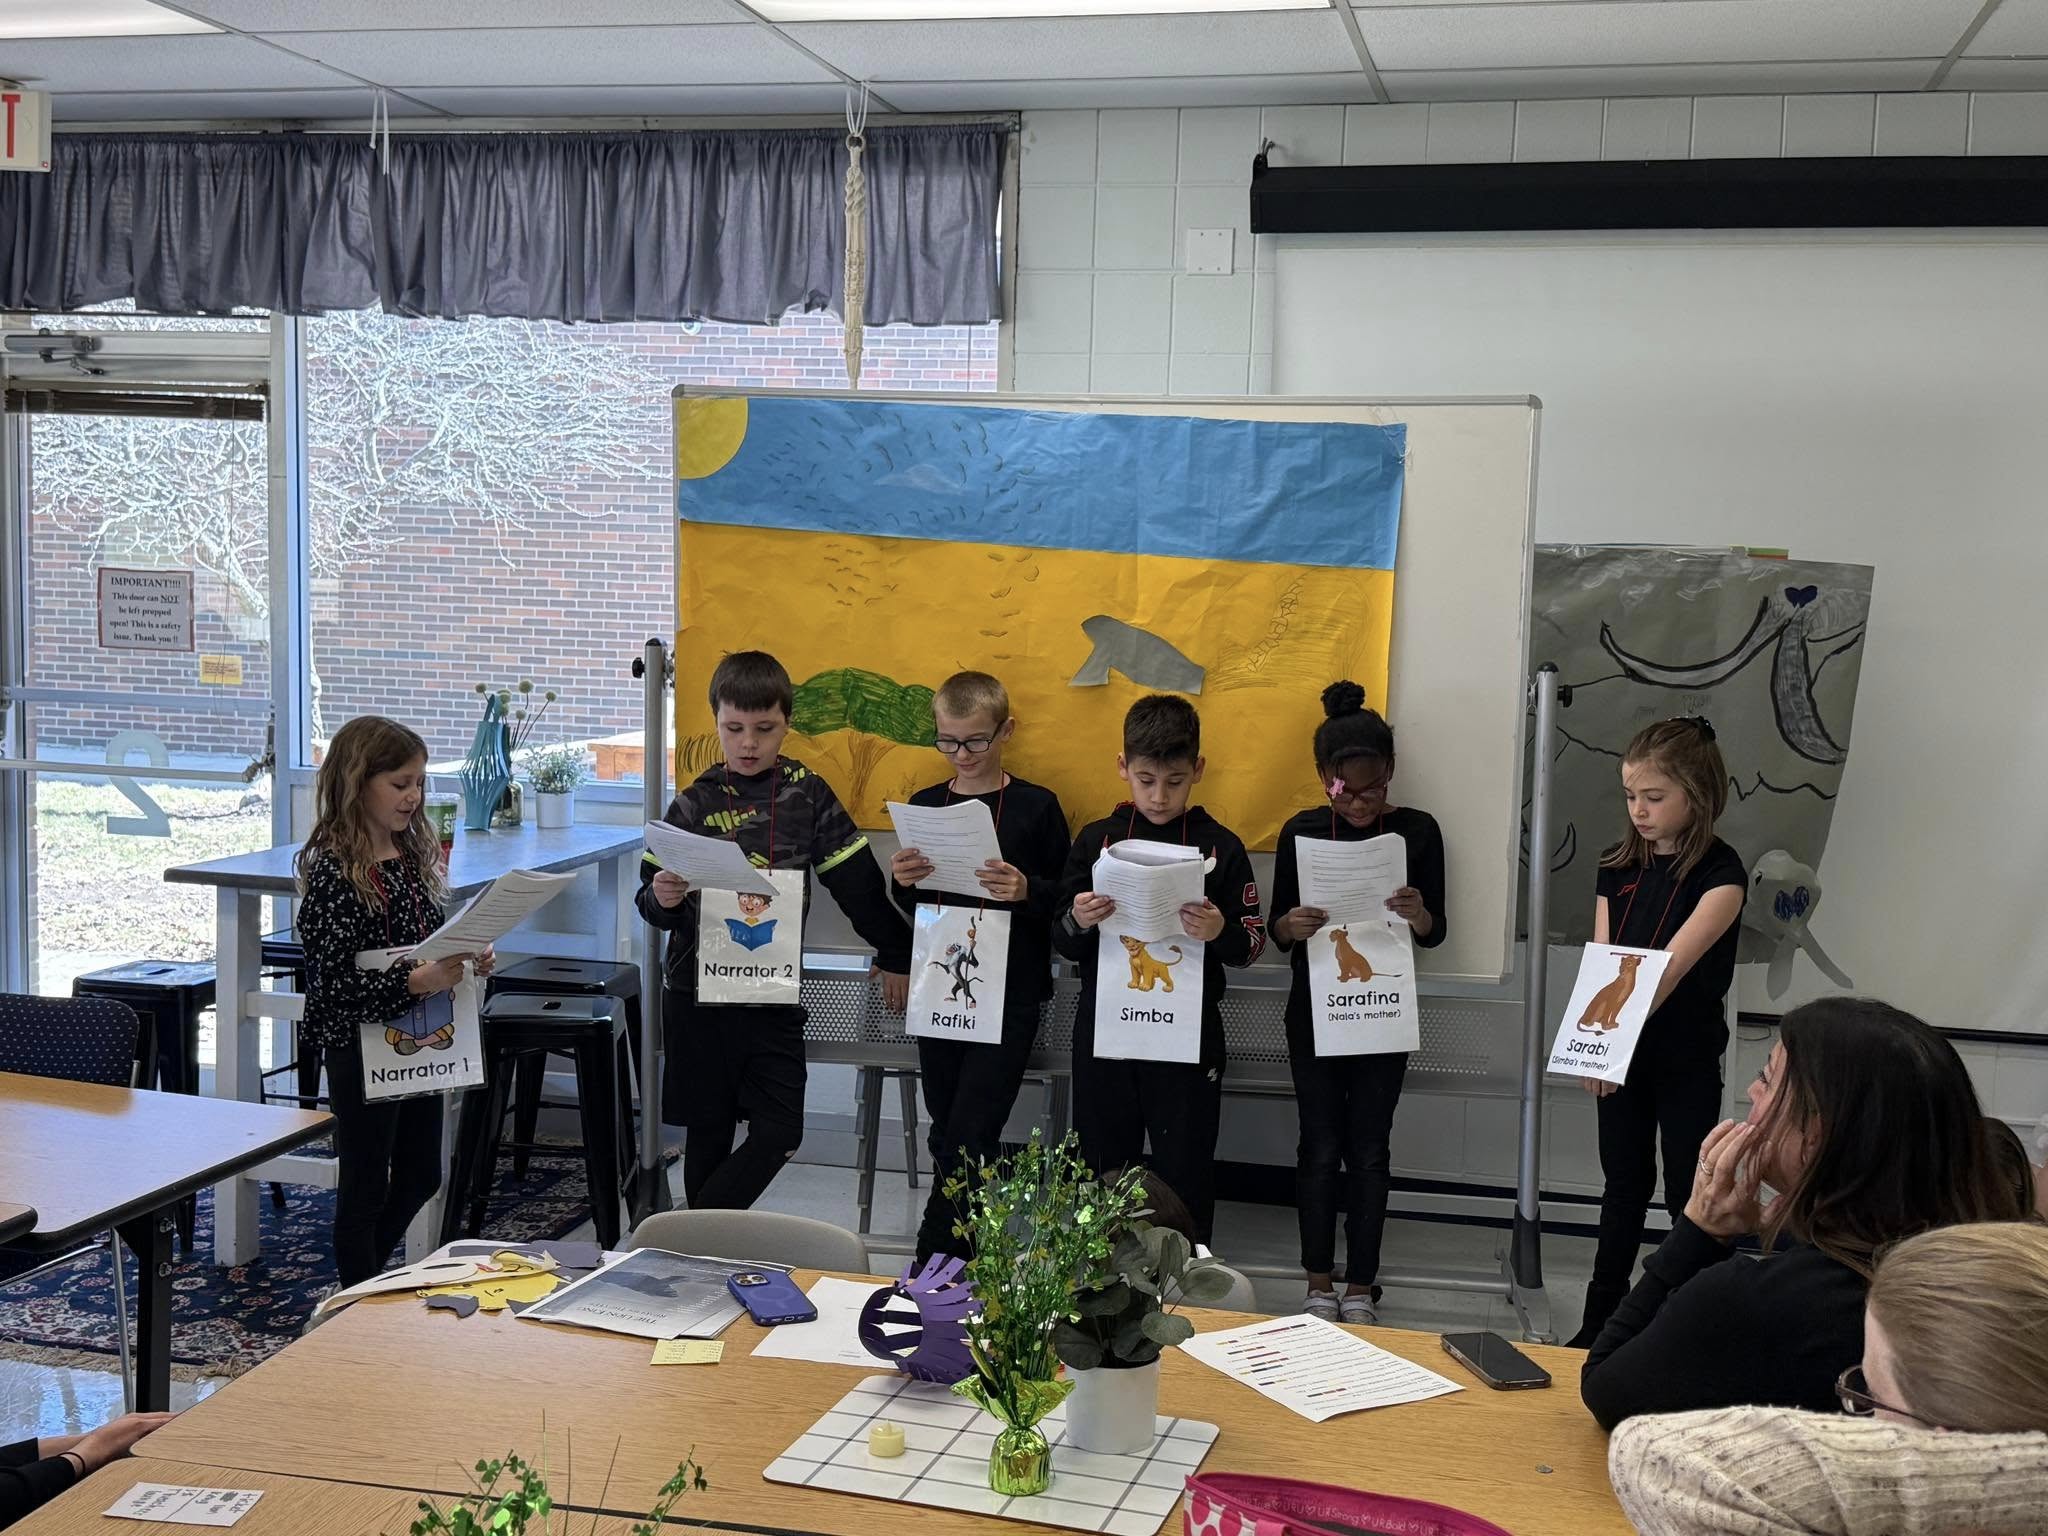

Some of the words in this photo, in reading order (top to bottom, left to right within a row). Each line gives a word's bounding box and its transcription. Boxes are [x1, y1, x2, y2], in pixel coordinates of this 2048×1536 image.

[111, 576, 181, 588] IMPORTANT!!!!
[112, 592, 128, 600] This
[129, 593, 145, 601] door
[160, 595, 179, 604] NOT
[128, 606, 140, 614] left
[142, 608, 172, 617] propped
[109, 620, 129, 629] open!
[131, 620, 146, 628] This
[161, 622, 181, 631] safety
[134, 633, 157, 642] Thank
[704, 963, 779, 979] Narrator
[783, 964, 793, 978] 2
[1326, 991, 1400, 1007] Sarafina
[931, 1012, 976, 1030] Rafiki
[1120, 1007, 1174, 1024] Simba
[1328, 1011, 1361, 1022] (Nala's
[1364, 1009, 1401, 1020] mother)
[1566, 1039, 1611, 1056] Sarabi
[371, 1060, 456, 1084] Narrator
[462, 1057, 470, 1073] 1
[1551, 1055, 1578, 1067] (Simba's
[1580, 1060, 1610, 1072] mother)
